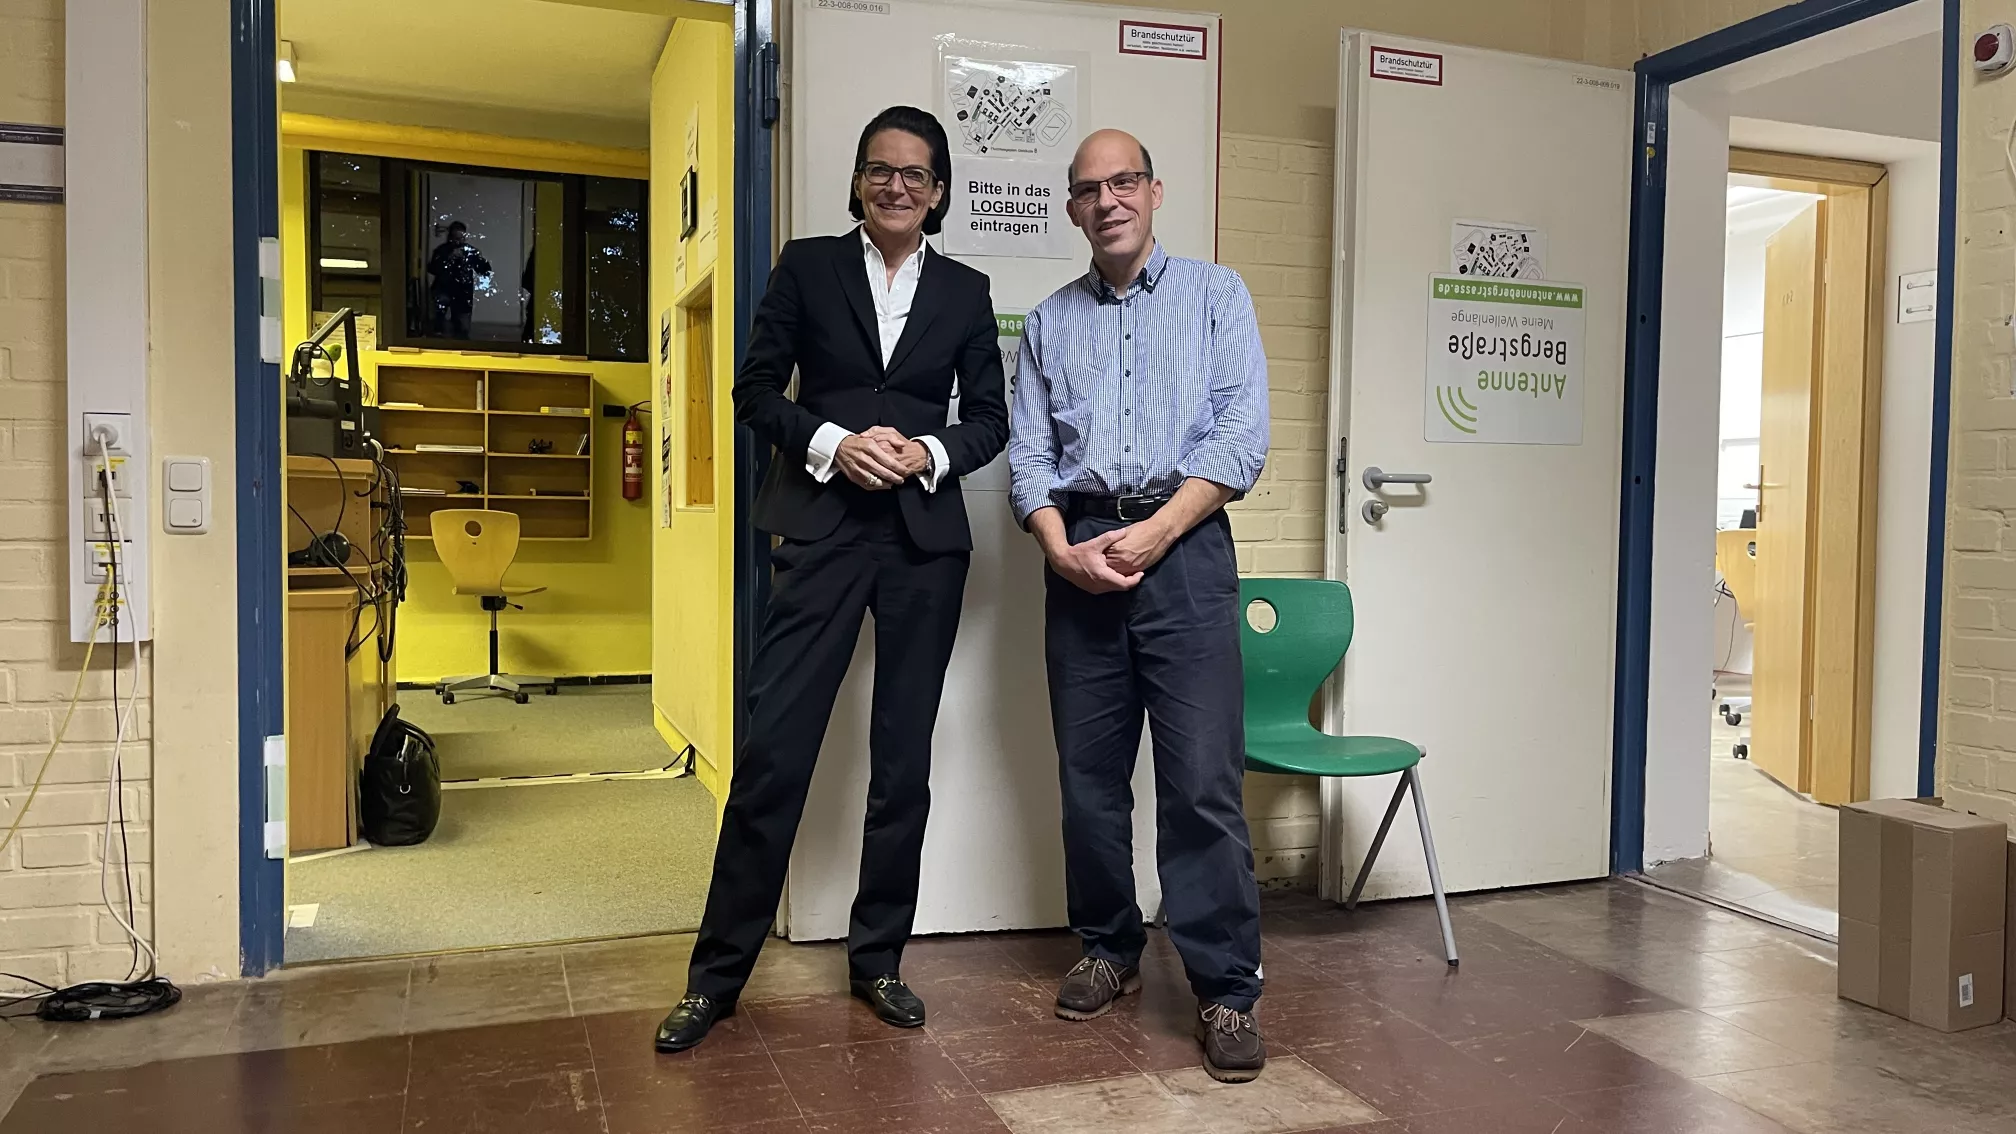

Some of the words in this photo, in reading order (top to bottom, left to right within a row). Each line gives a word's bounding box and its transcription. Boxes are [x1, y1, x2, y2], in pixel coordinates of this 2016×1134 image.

[1131, 28, 1195, 42] Brandschutztür
[1380, 54, 1433, 69] Brandschutztür
[969, 180, 1002, 195] Bitte
[1007, 182, 1020, 196] in
[1025, 184, 1051, 197] das
[971, 199, 1048, 216] LOGBUCH
[970, 219, 1039, 236] eintragen
[1044, 221, 1048, 234] !
[1438, 283, 1579, 302] www.antennebergstrasse.de
[1451, 309, 1518, 328] Wellenlänge
[1521, 315, 1554, 331] Meine
[1448, 331, 1567, 365] Bergstraße
[1477, 370, 1567, 399] Antenne
